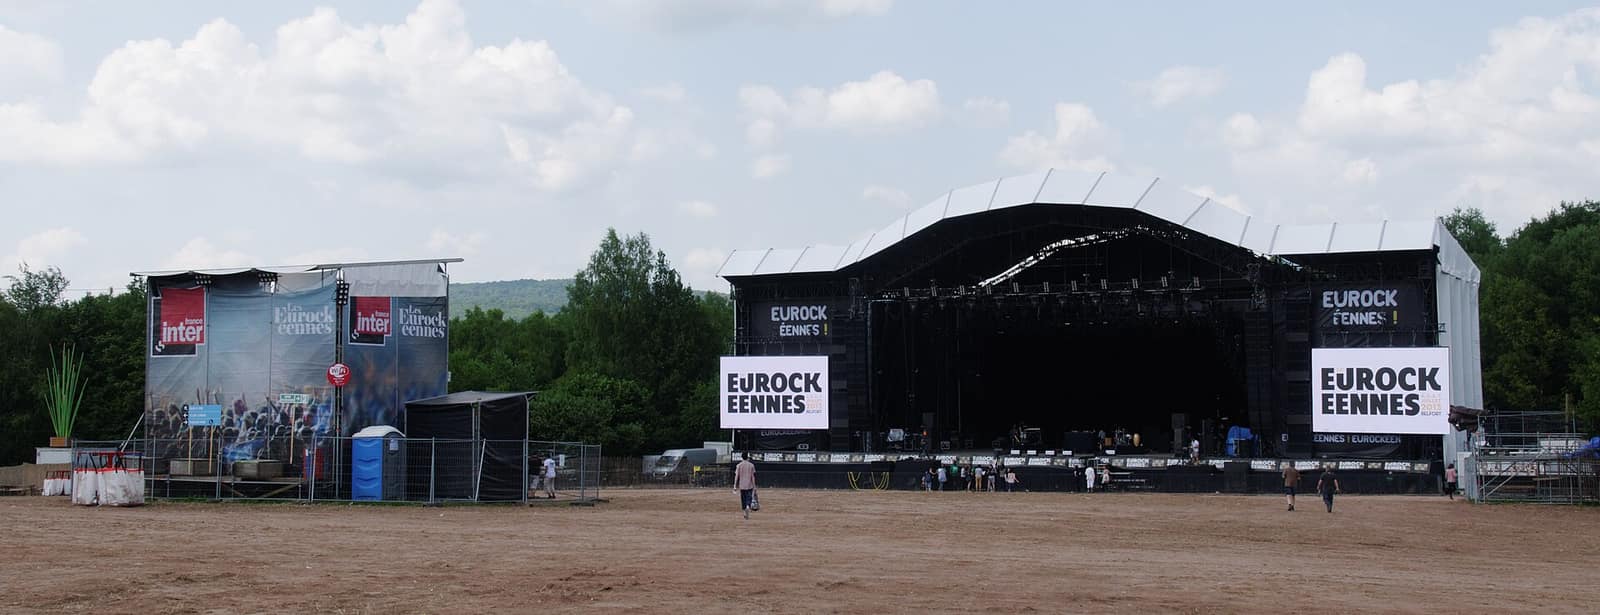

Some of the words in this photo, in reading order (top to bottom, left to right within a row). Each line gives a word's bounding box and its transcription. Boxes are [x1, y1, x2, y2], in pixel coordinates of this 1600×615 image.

[1323, 289, 1398, 308] EUROCK
[274, 306, 334, 323] Eurock
[400, 308, 446, 328] Eurock
[409, 304, 421, 314] Les
[771, 305, 827, 321] EUROCK
[162, 321, 203, 342] inter
[357, 312, 389, 333] inter
[728, 373, 822, 393] EUROCK
[1321, 367, 1441, 391] EUROCK
[728, 395, 805, 414] EENNES
[1321, 393, 1420, 416] EENNES
